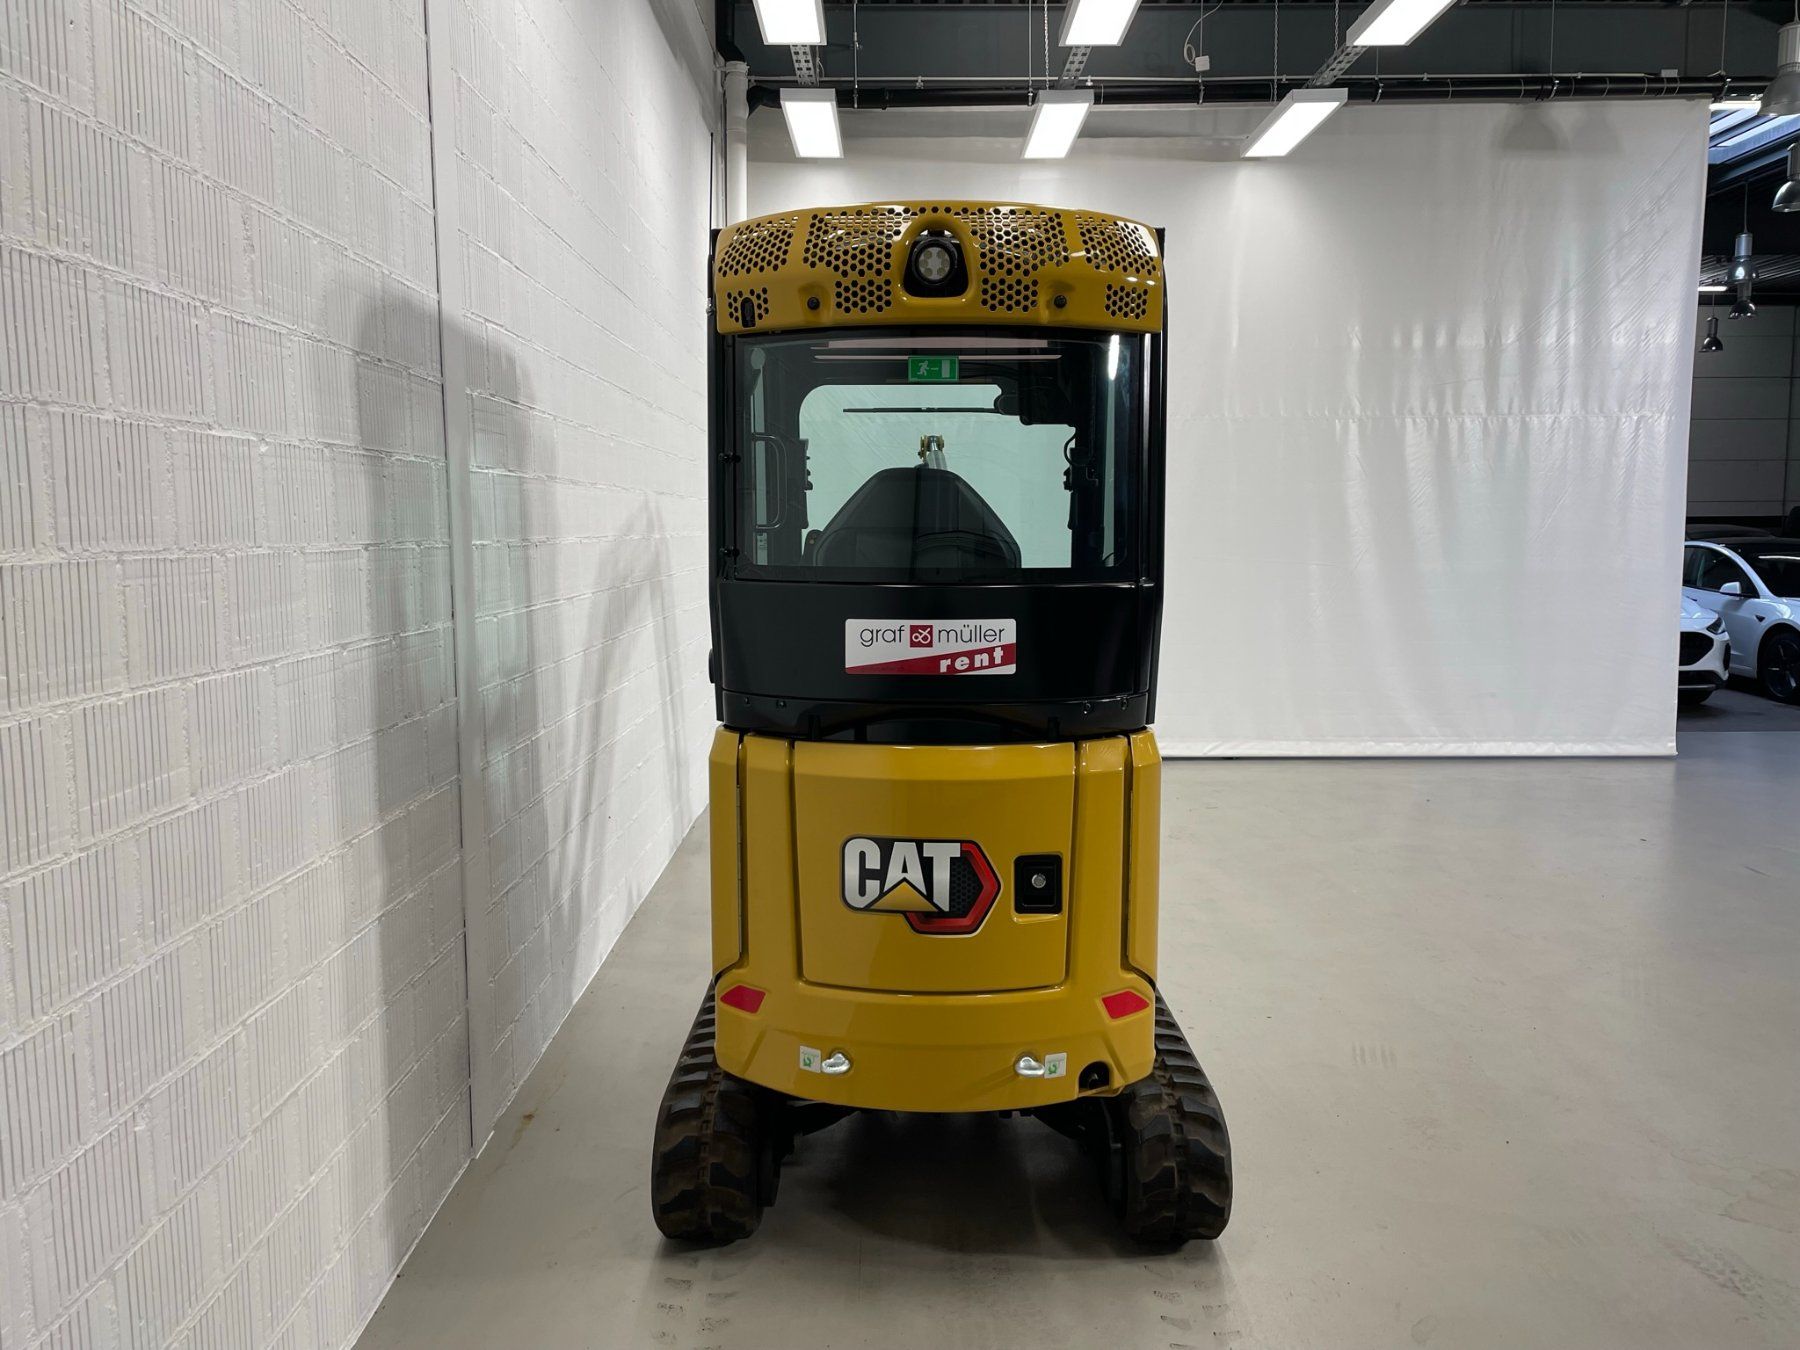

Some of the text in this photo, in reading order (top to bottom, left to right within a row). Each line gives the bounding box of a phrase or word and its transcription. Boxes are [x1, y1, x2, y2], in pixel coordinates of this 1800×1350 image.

[859, 624, 905, 648] graf
[938, 624, 1005, 643] müller
[939, 647, 1004, 674] rent
[844, 837, 961, 913] CAT
